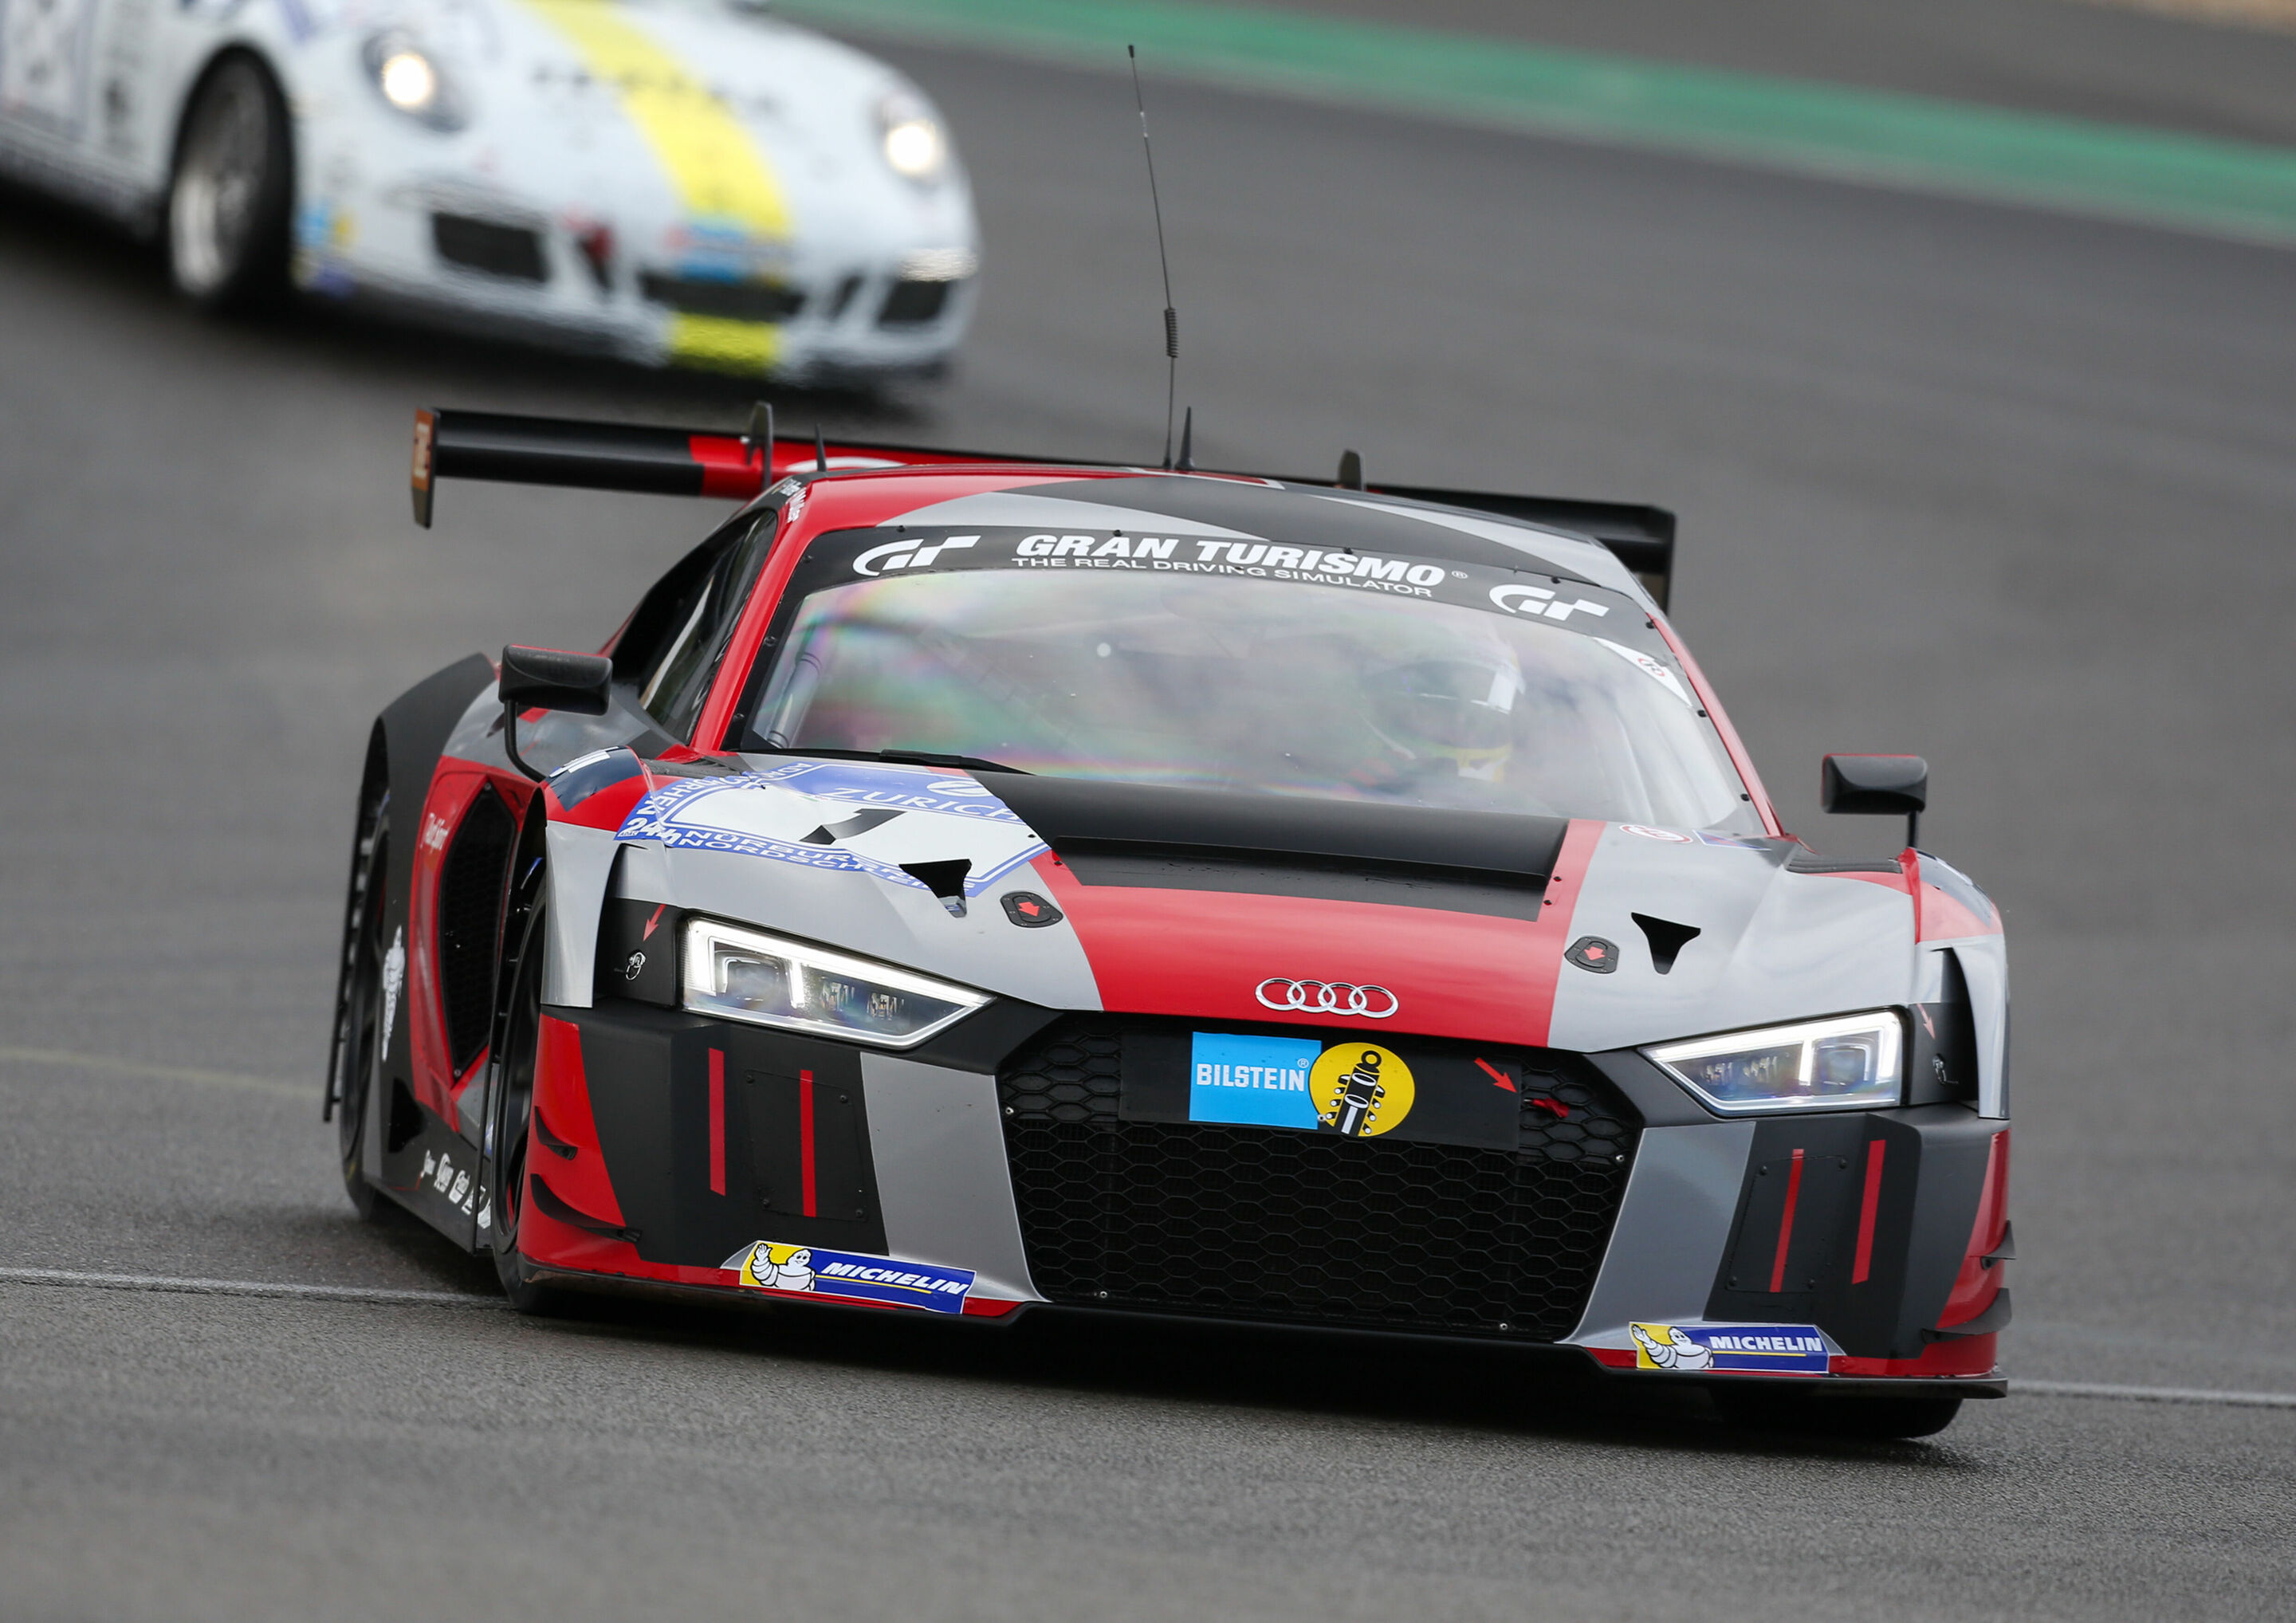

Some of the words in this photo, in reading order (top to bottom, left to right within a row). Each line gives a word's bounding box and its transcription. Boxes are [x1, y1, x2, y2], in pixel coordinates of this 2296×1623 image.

[1016, 535, 1178, 559] GRAN
[1196, 540, 1445, 586] TURISMO
[1012, 558, 1069, 568] THE
[1074, 558, 1146, 569] REAL
[1153, 560, 1267, 576] DRIVING
[1274, 568, 1432, 597] SIMULATOR
[1197, 1063, 1304, 1091] BILSTEIN
[821, 1262, 969, 1295] MICHELIN
[1709, 1336, 1822, 1351] MICHELIN
